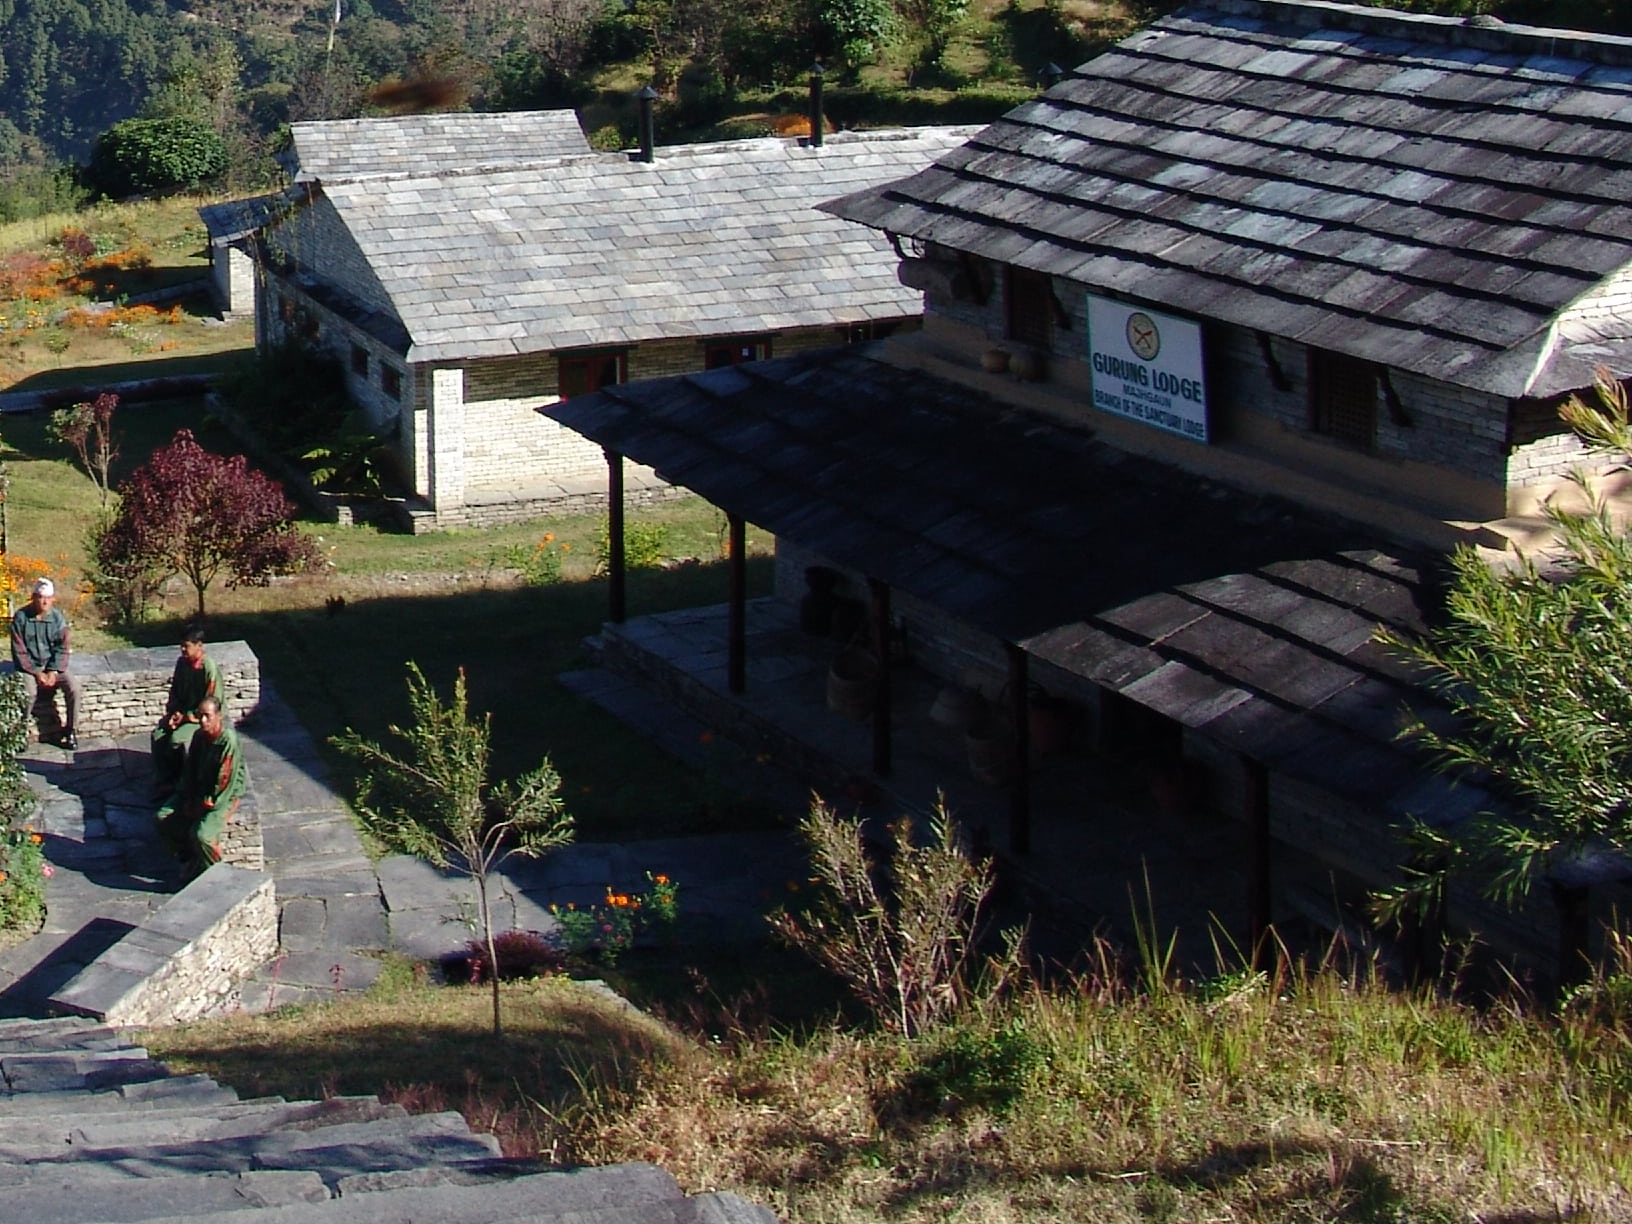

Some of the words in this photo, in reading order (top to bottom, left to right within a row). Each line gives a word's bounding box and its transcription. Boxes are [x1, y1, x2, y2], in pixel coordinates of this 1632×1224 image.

[1093, 352, 1148, 386] GURUNG
[1152, 369, 1202, 403] LODGE
[1095, 389, 1122, 410] BRANCH
[1122, 398, 1131, 413] OF
[1131, 401, 1144, 418] THE
[1144, 406, 1182, 430] SANCTUARY
[1183, 418, 1205, 438] LODGE
